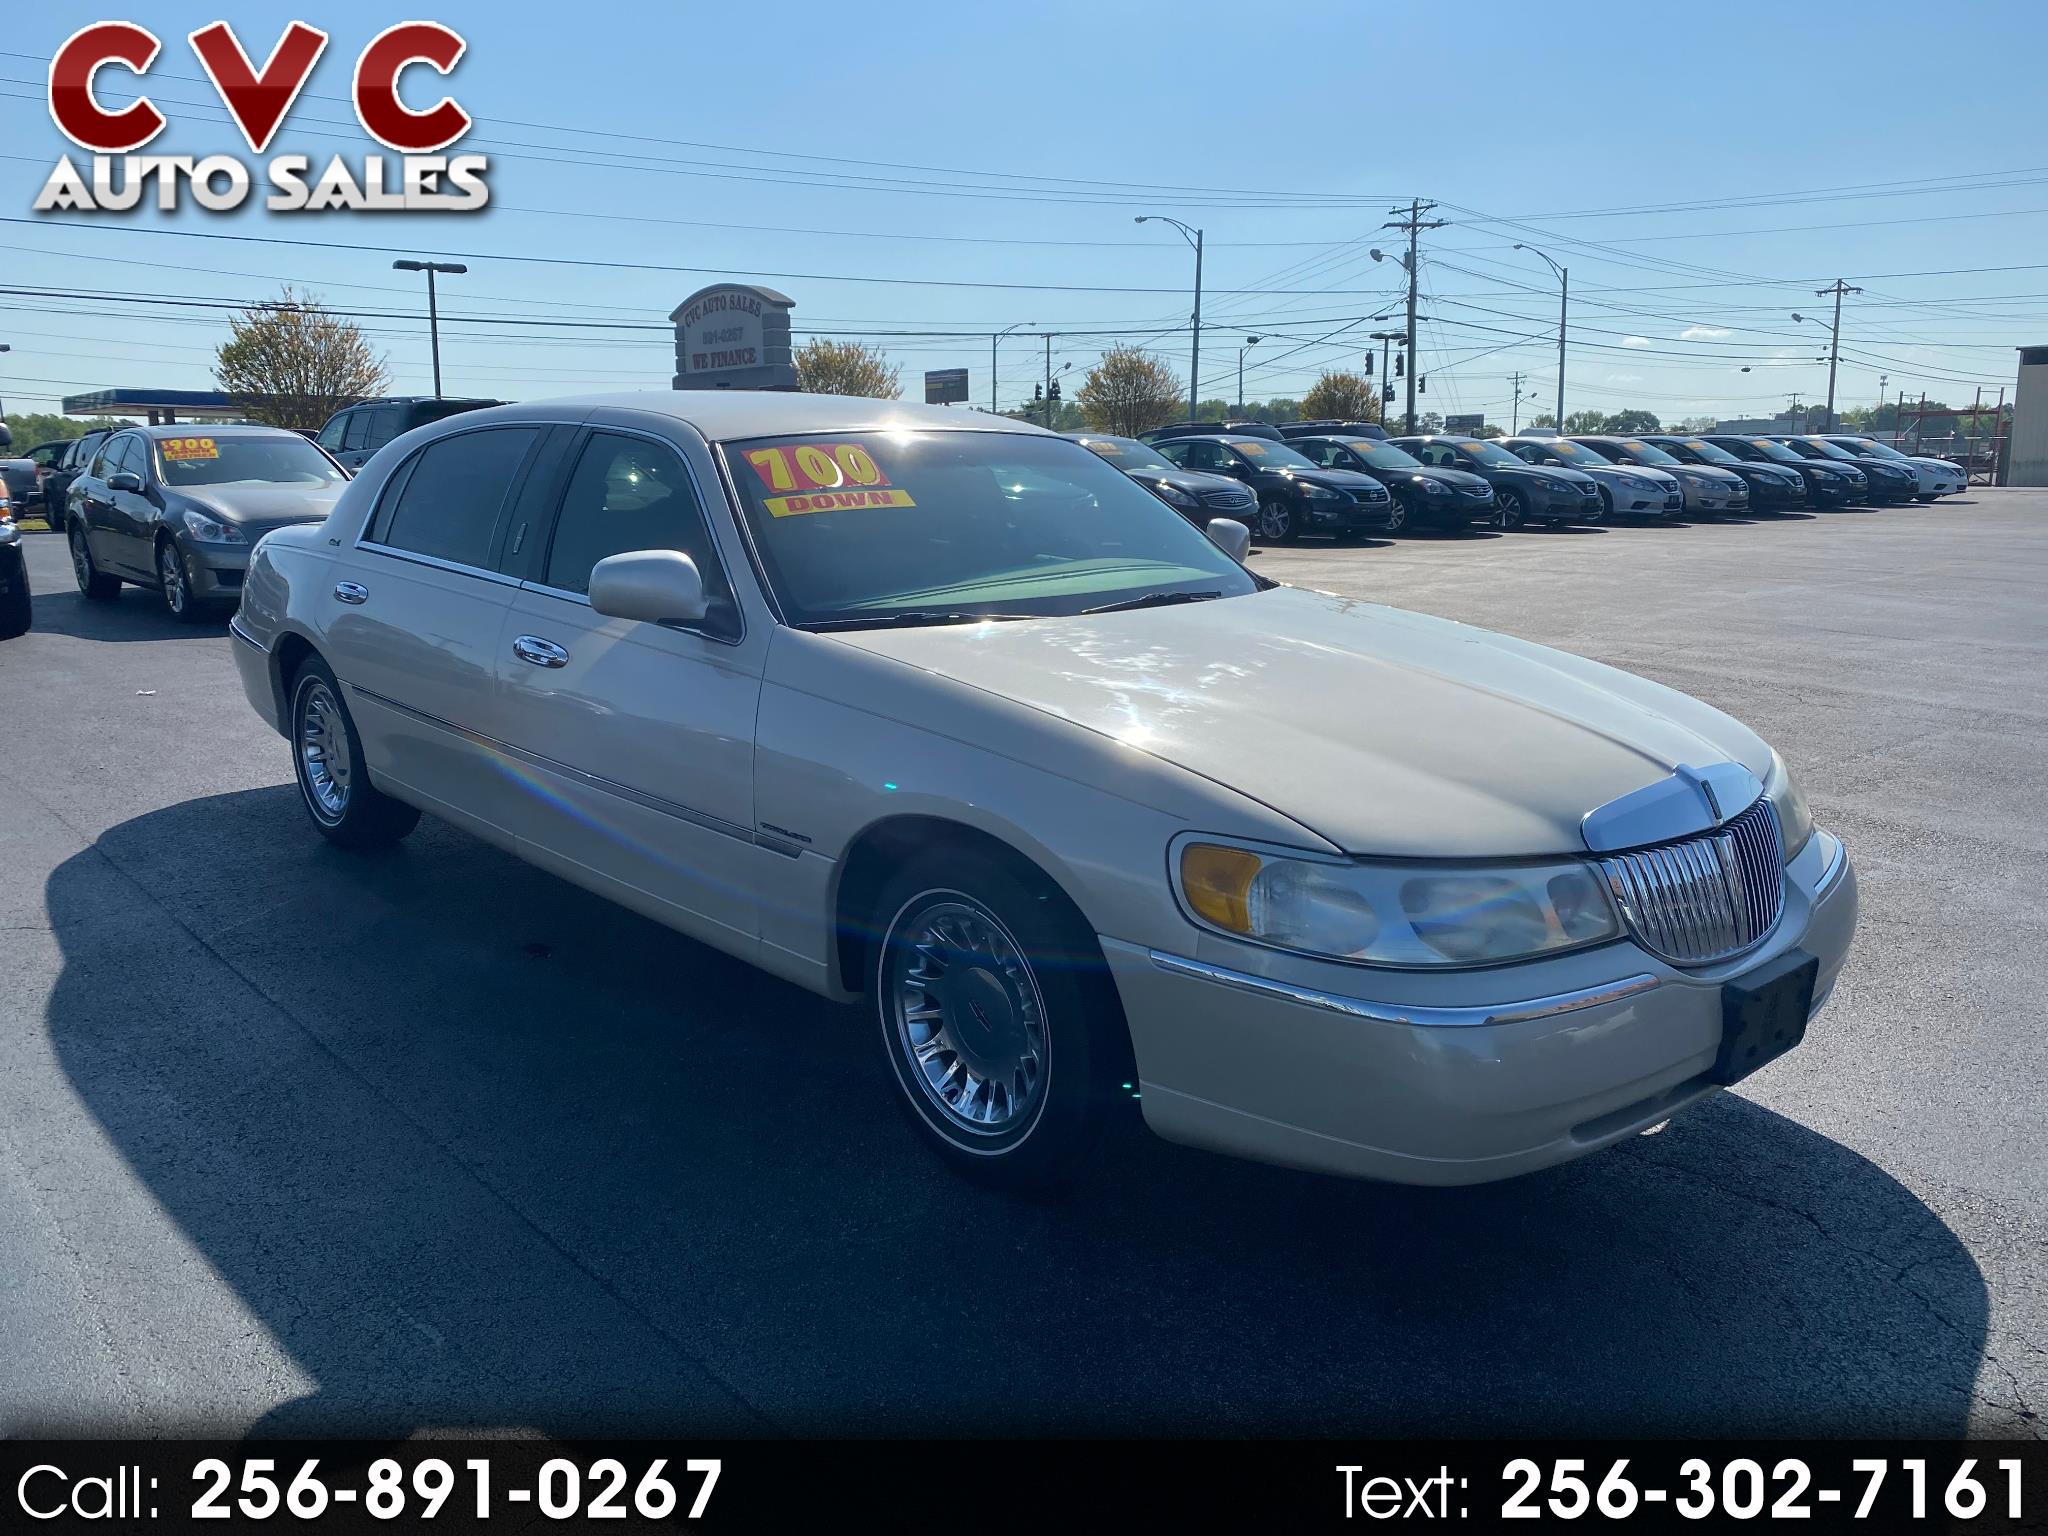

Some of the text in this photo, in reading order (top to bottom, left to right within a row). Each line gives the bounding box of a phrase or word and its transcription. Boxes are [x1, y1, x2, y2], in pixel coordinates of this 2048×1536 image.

[684, 294, 762, 328] CVC AUTO SALES
[693, 347, 757, 370] WE FINANCE
[749, 444, 881, 491] 700
[785, 491, 894, 514] DOWN
